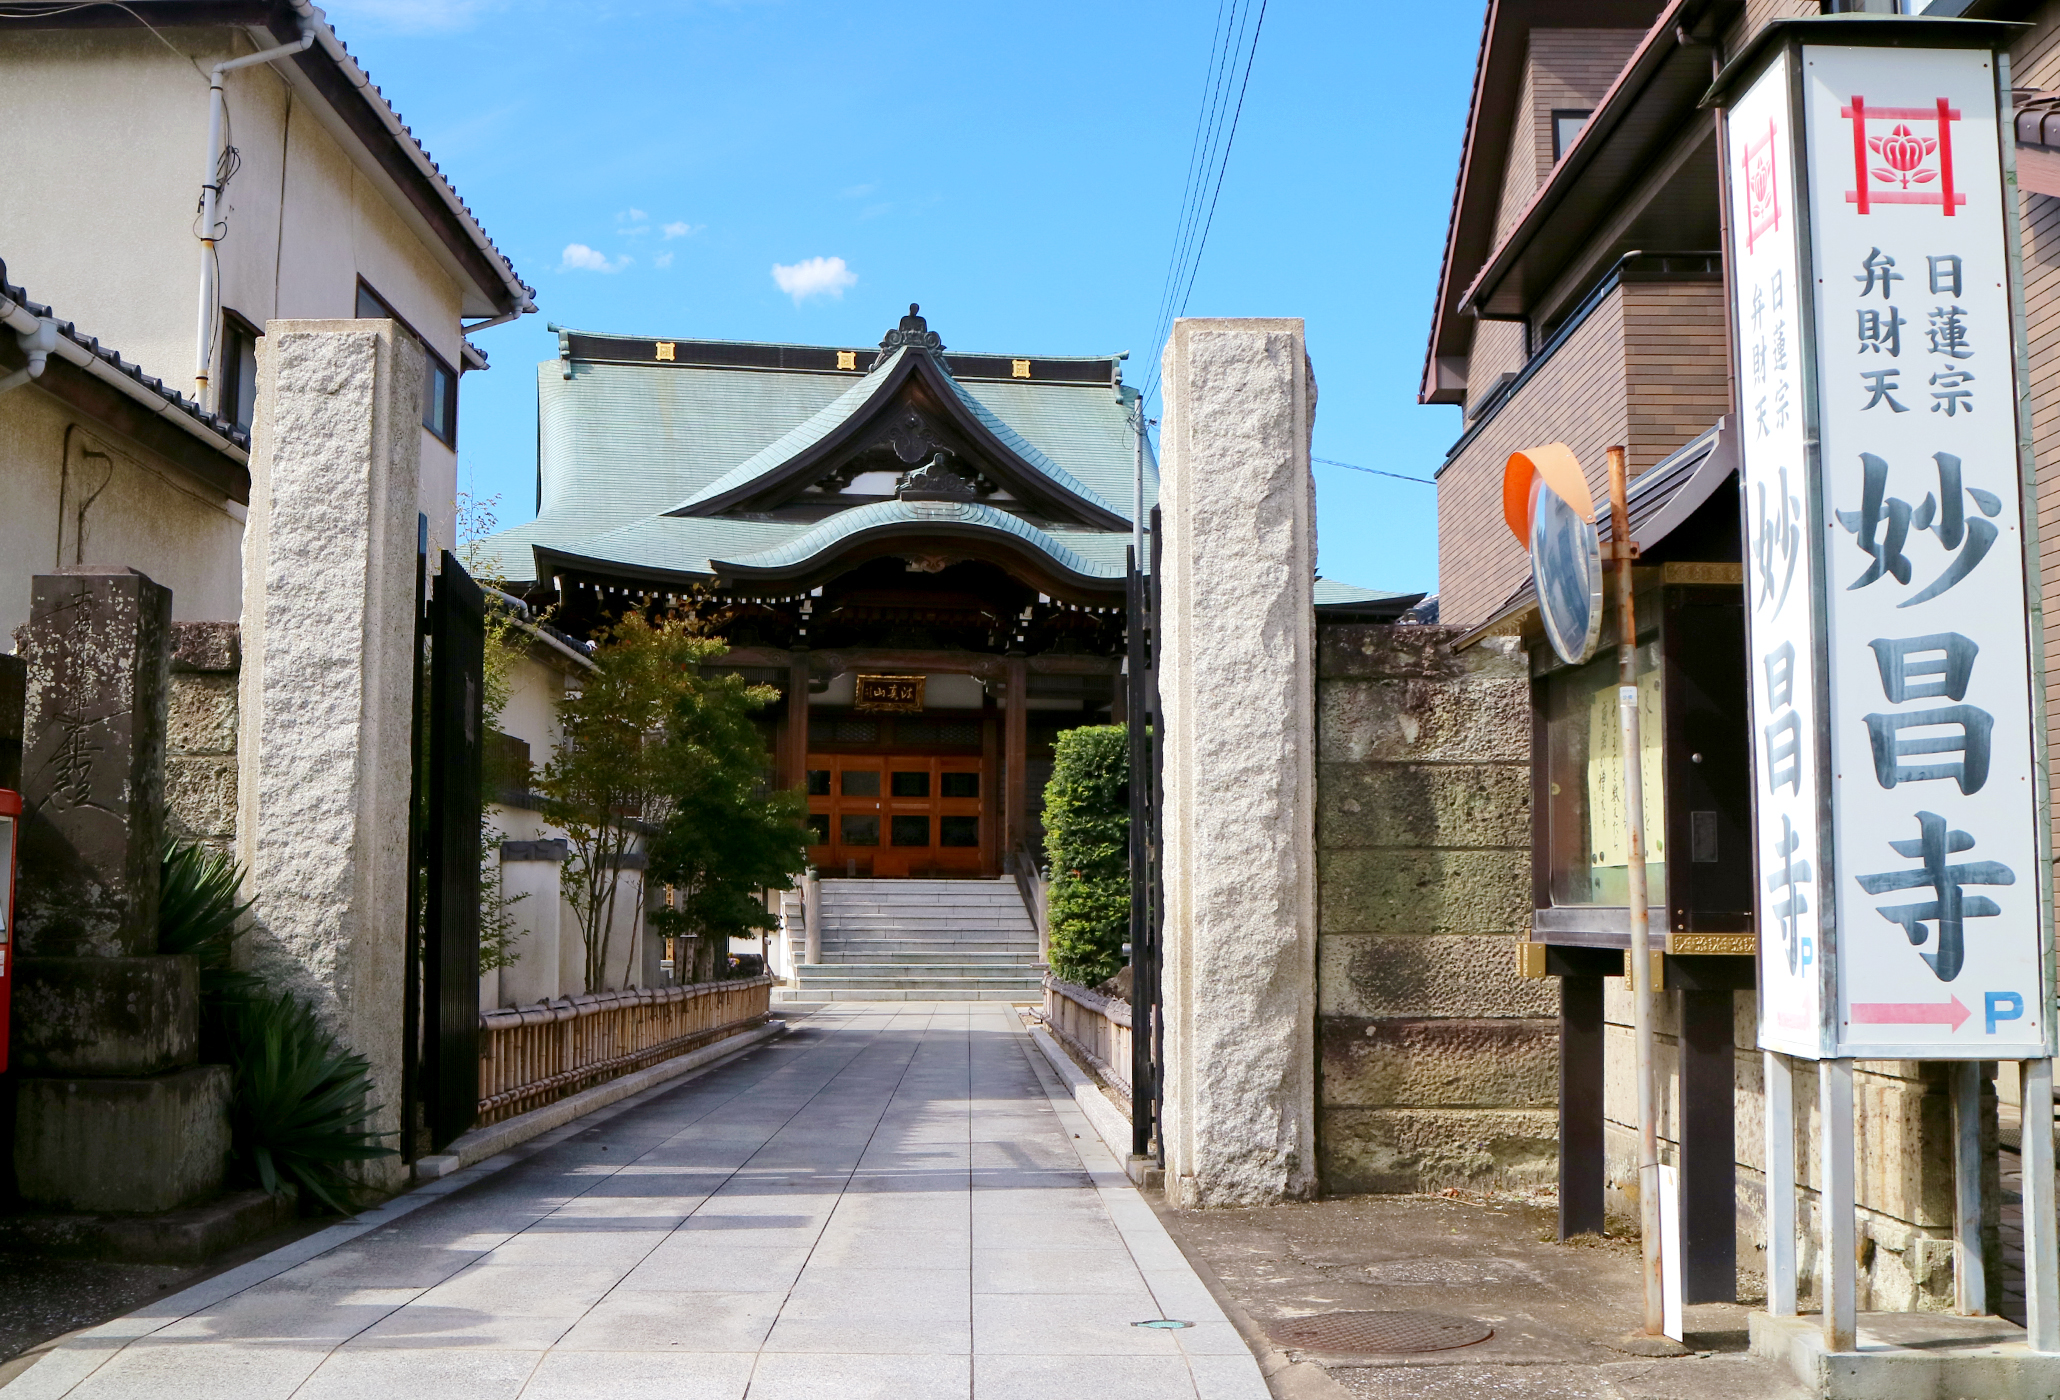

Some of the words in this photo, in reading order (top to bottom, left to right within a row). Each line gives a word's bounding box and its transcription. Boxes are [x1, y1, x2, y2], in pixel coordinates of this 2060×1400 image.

[1750, 282, 1770, 443] 弁財天
[1769, 268, 1790, 429] 日蓮宗
[1853, 246, 1910, 413] 弁財天
[1925, 253, 1975, 417] 日蓮宗
[1751, 465, 1812, 977] 妙昌寺
[1835, 451, 2016, 982] 妙昌寺
[1800, 936, 1813, 979] P
[1984, 991, 2024, 1035] P
